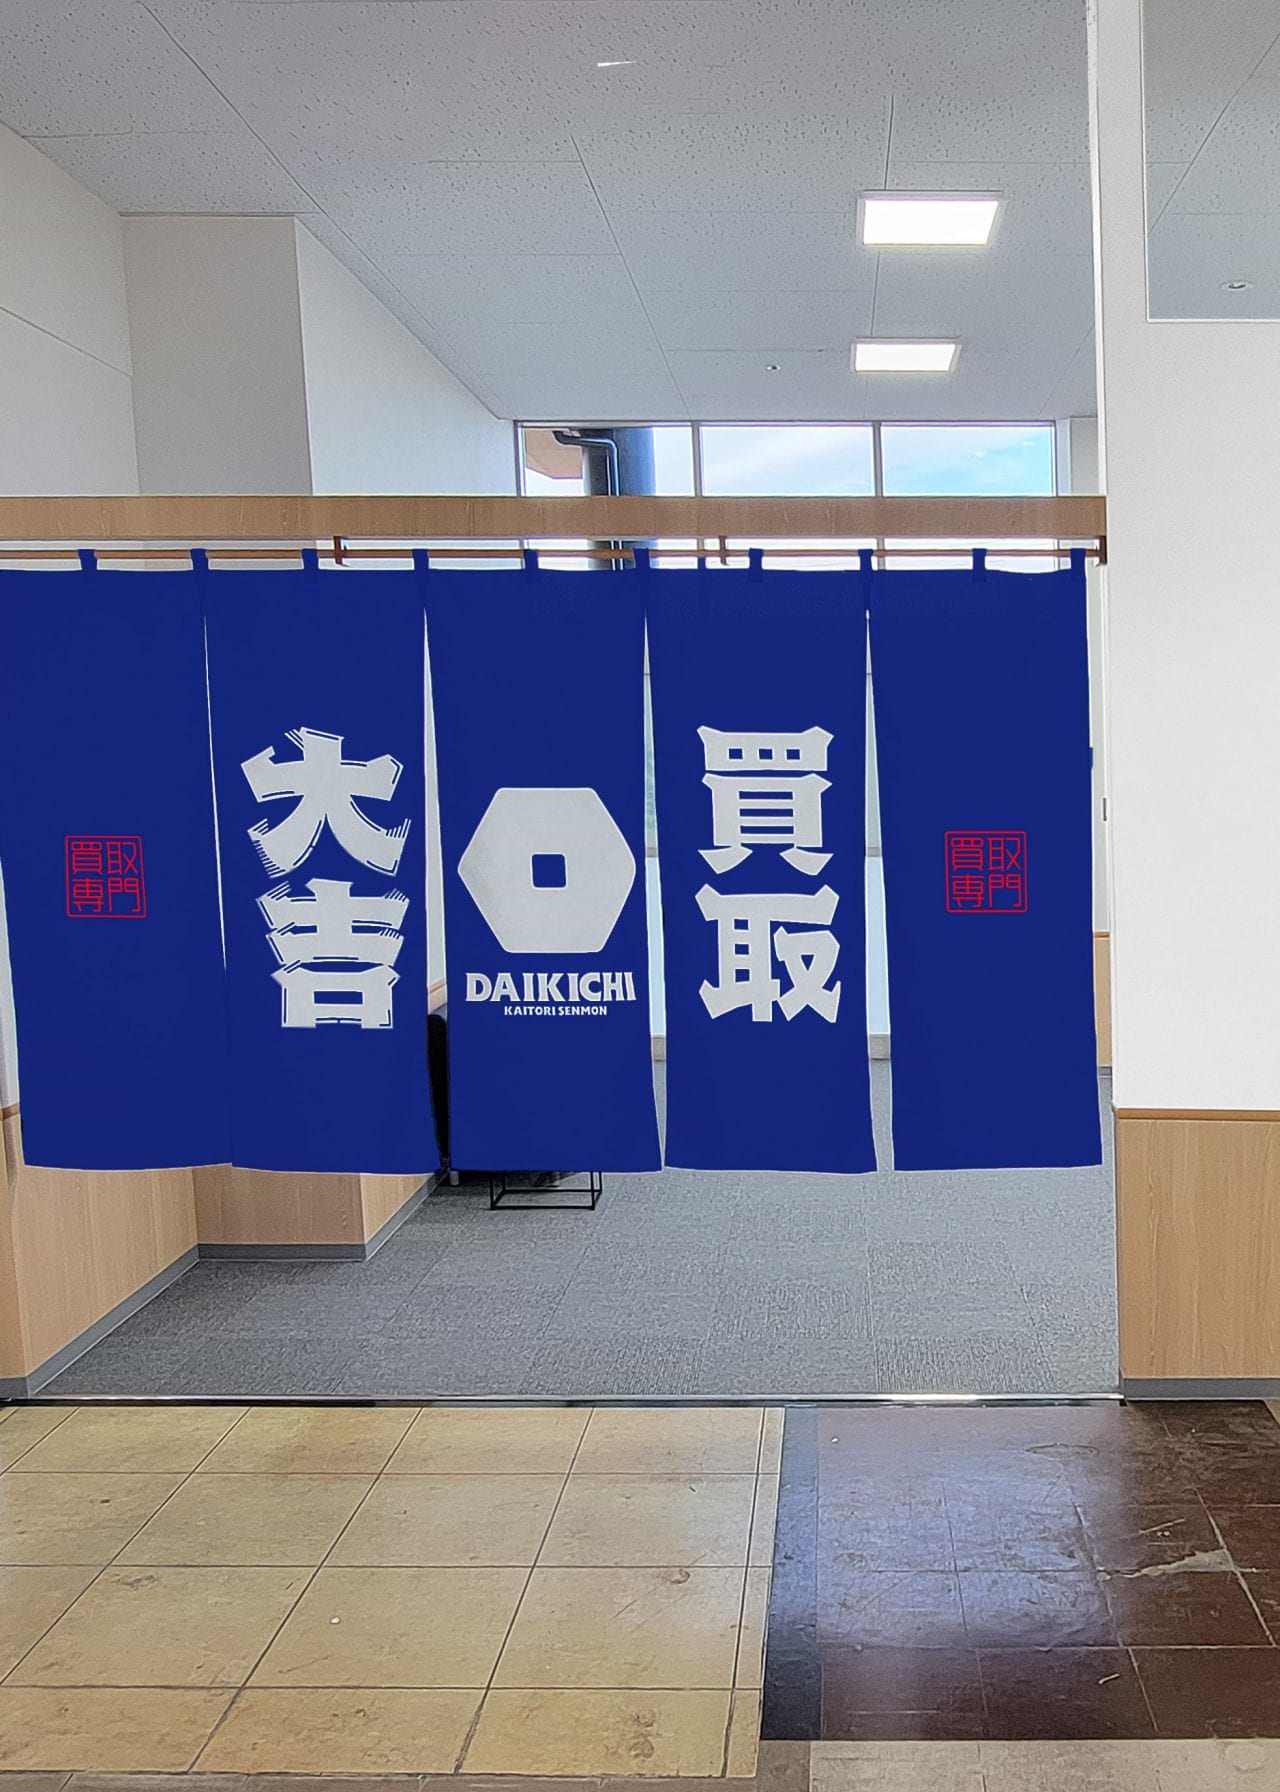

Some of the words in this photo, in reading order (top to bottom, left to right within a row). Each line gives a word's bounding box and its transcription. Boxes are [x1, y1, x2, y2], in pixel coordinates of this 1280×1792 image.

[241, 727, 411, 1029] 大吉
[695, 725, 841, 1023] 買取
[466, 972, 637, 1002] DAIKICHI
[504, 1006, 557, 1016] KAITORI
[558, 1006, 608, 1017] SENMON
